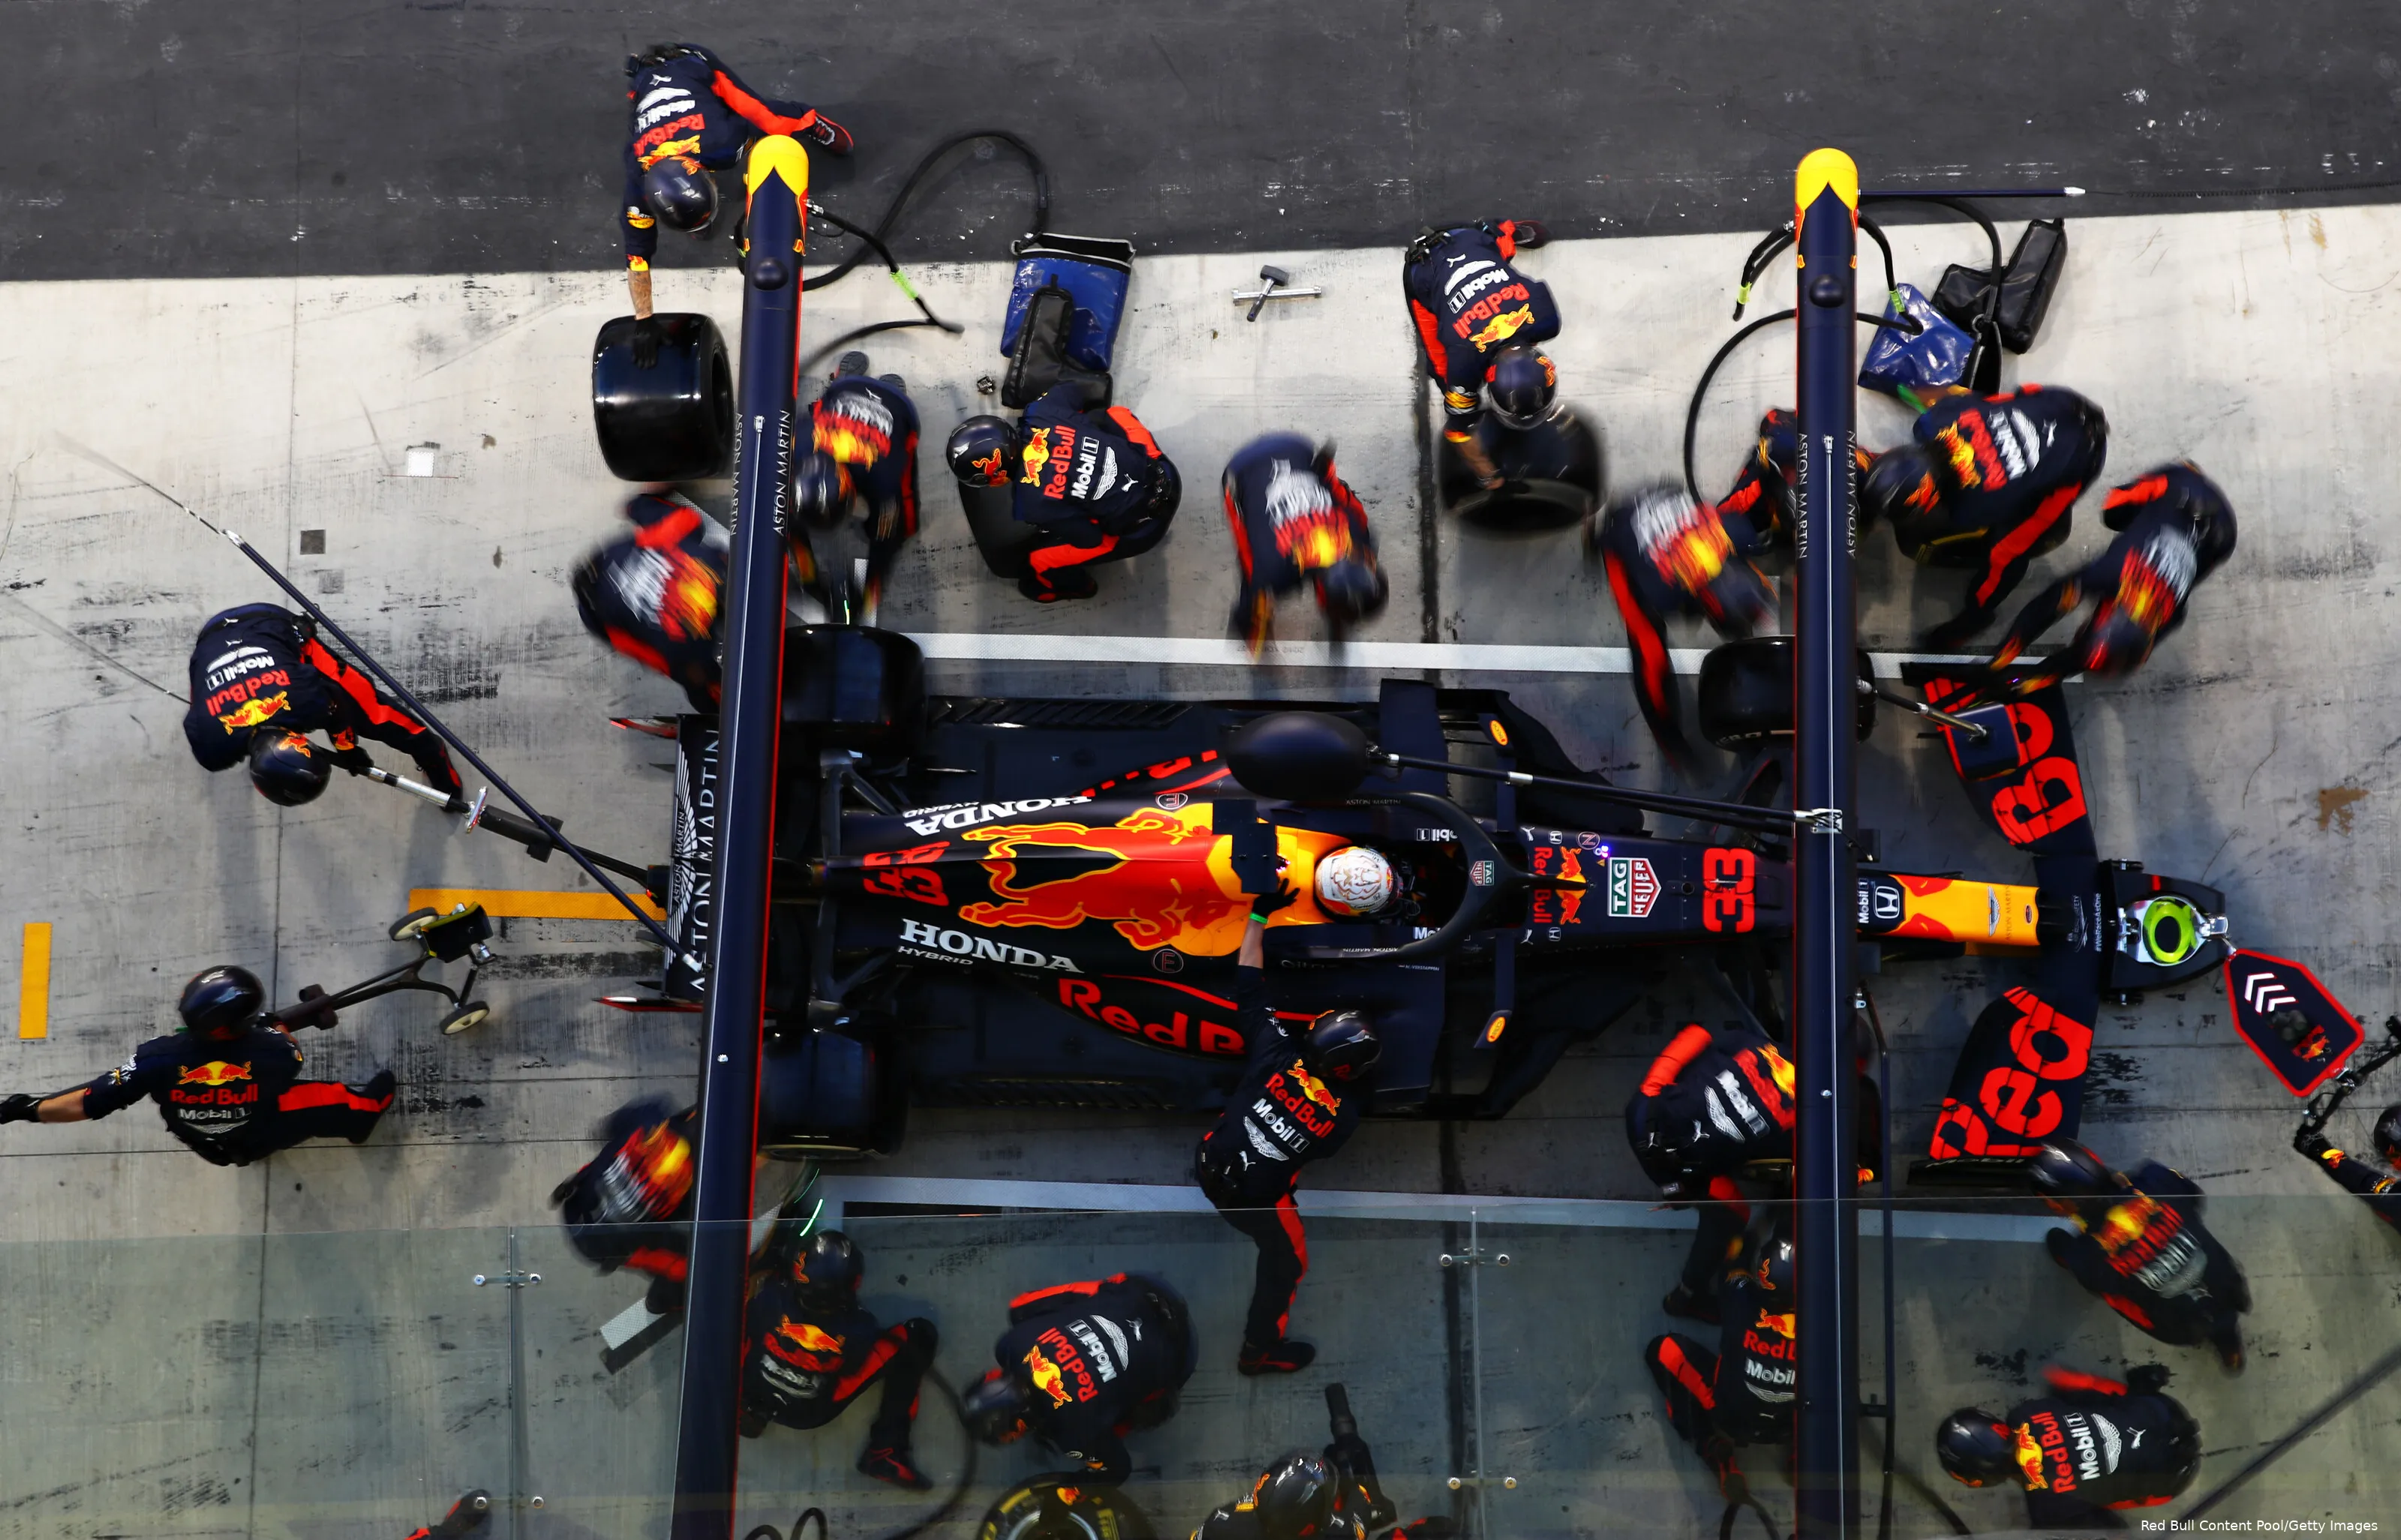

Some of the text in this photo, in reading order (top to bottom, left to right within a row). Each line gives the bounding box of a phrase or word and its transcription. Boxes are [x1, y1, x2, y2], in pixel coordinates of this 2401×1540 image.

[1461, 269, 1510, 300] Mobil
[729, 413, 743, 536] ASTON MARTIN
[772, 410, 791, 537] ASTON MARTIN
[1070, 452, 1096, 500] Mobil
[1797, 433, 1808, 559] ASTON MARTIN
[1847, 430, 1857, 559] ASTON MARTIN
[225, 656, 275, 683] Mobil
[903, 796, 1092, 836] HONDA
[1473, 863, 1483, 884] HEUER
[1612, 861, 1627, 911] TAG
[1632, 860, 1651, 914] HEUER
[1702, 848, 1755, 933] 33
[1858, 890, 1870, 924] Mobil
[897, 945, 974, 966] HYBRID
[901, 918, 1085, 974] HONDA
[1059, 977, 1189, 1049] Red
[170, 1083, 258, 1105] Red Bull
[179, 1108, 232, 1121] Mobil
[1252, 1097, 1297, 1142] Mobil
[1265, 1073, 1336, 1138] Red Bull
[1036, 1327, 1099, 1403] Red Bull
[1077, 1331, 1117, 1383] Mobil
[1743, 1328, 1786, 1359] Red
[1745, 1358, 1795, 1385] Mobil
[2030, 1412, 2077, 1493] Red Bull
[2069, 1426, 2100, 1481] Mobil
